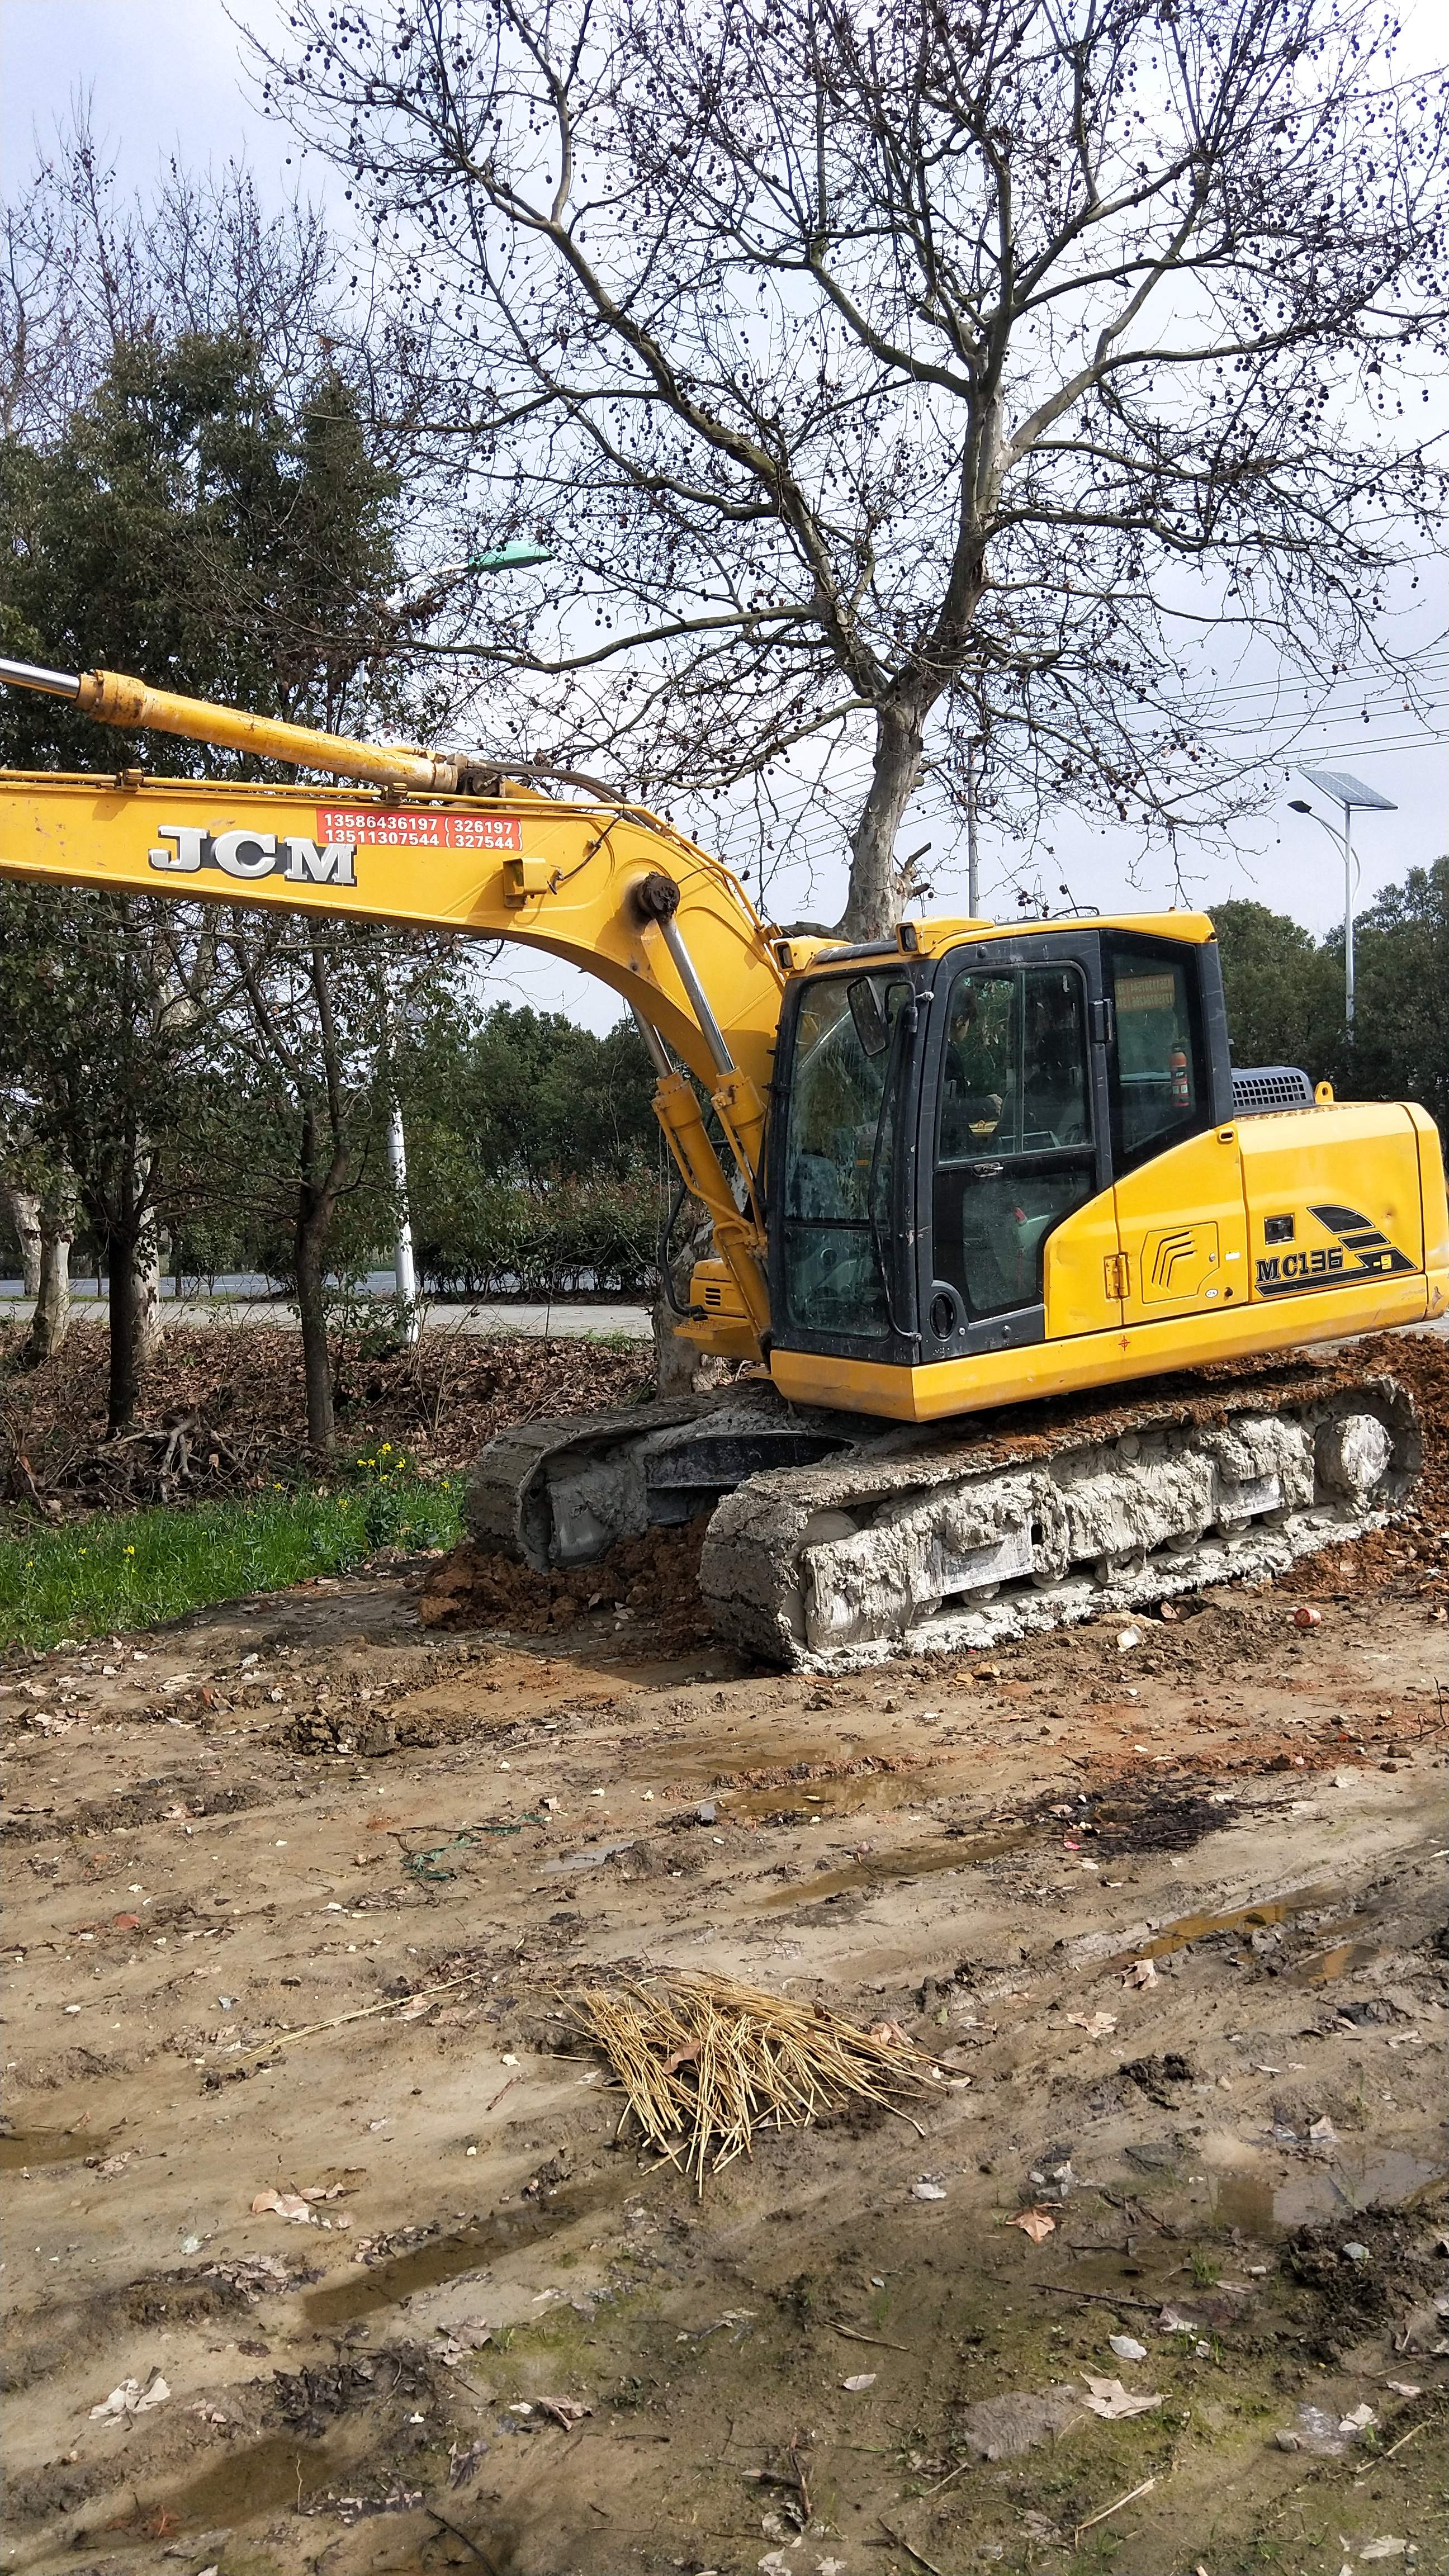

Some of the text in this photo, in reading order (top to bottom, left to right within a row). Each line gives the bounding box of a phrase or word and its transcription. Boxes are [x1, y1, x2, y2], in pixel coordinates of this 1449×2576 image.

[324, 813, 437, 831] 13586436197
[325, 829, 439, 846] 13511307544
[148, 825, 357, 886] JCM
[1255, 1246, 1344, 1283] MC136
